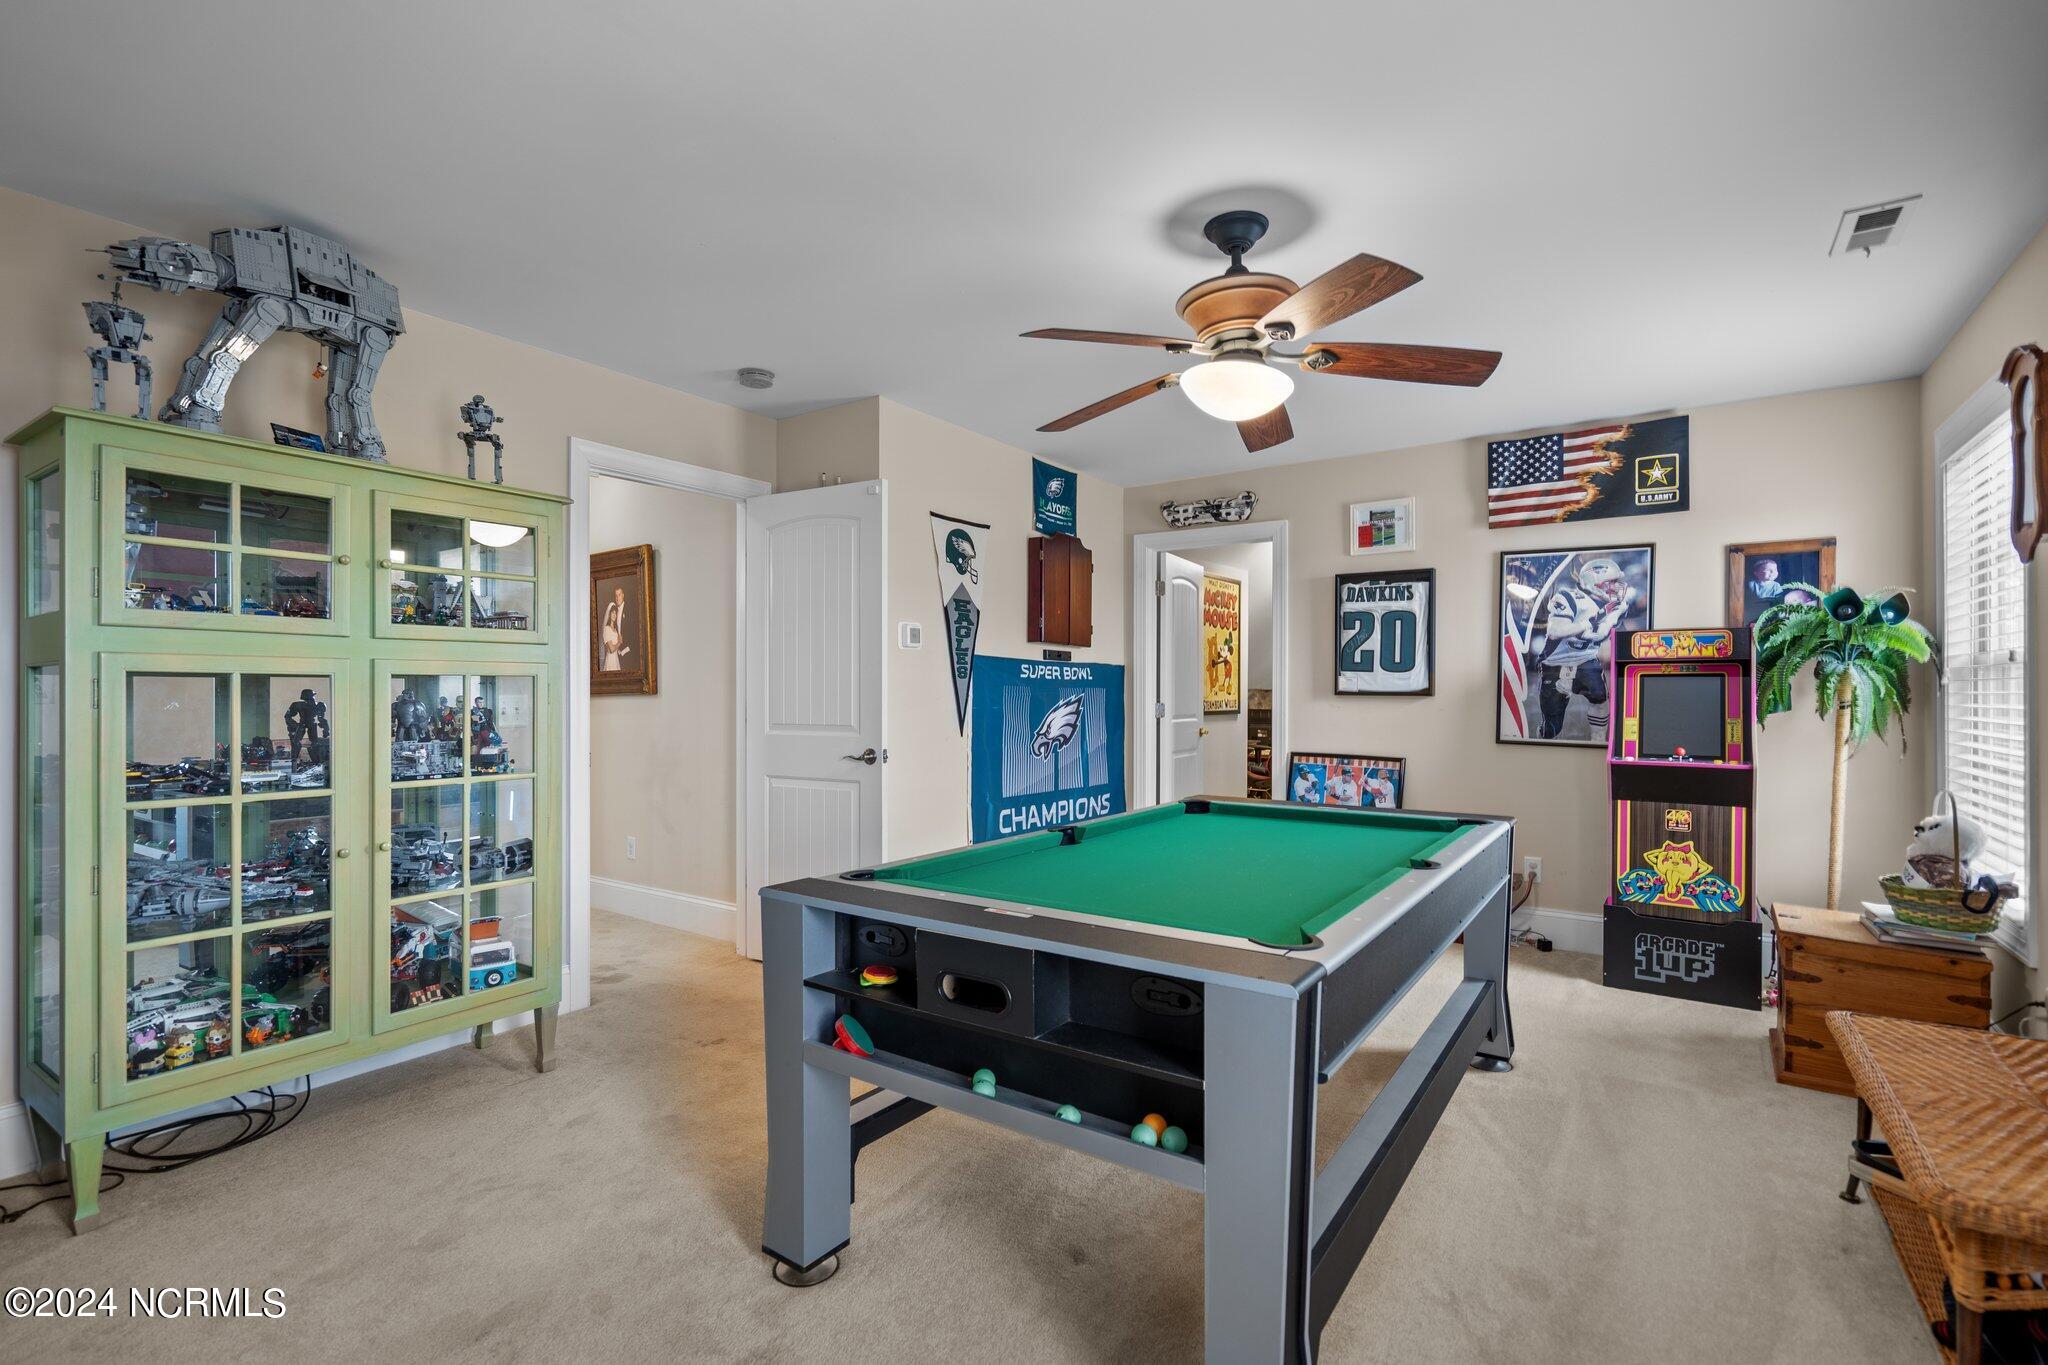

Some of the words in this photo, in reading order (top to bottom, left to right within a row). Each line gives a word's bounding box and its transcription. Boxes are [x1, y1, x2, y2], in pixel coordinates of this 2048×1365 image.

[1345, 584, 1415, 603] DAWKINS
[1203, 608, 1238, 631] MOUSE
[953, 598, 975, 680] EAGLES
[1340, 609, 1417, 673] 20
[1020, 664, 1061, 680] SUPER
[1063, 666, 1093, 680] BOWL
[999, 792, 1110, 834] CHAMPIONS
[1635, 933, 1715, 959] ARCADE
